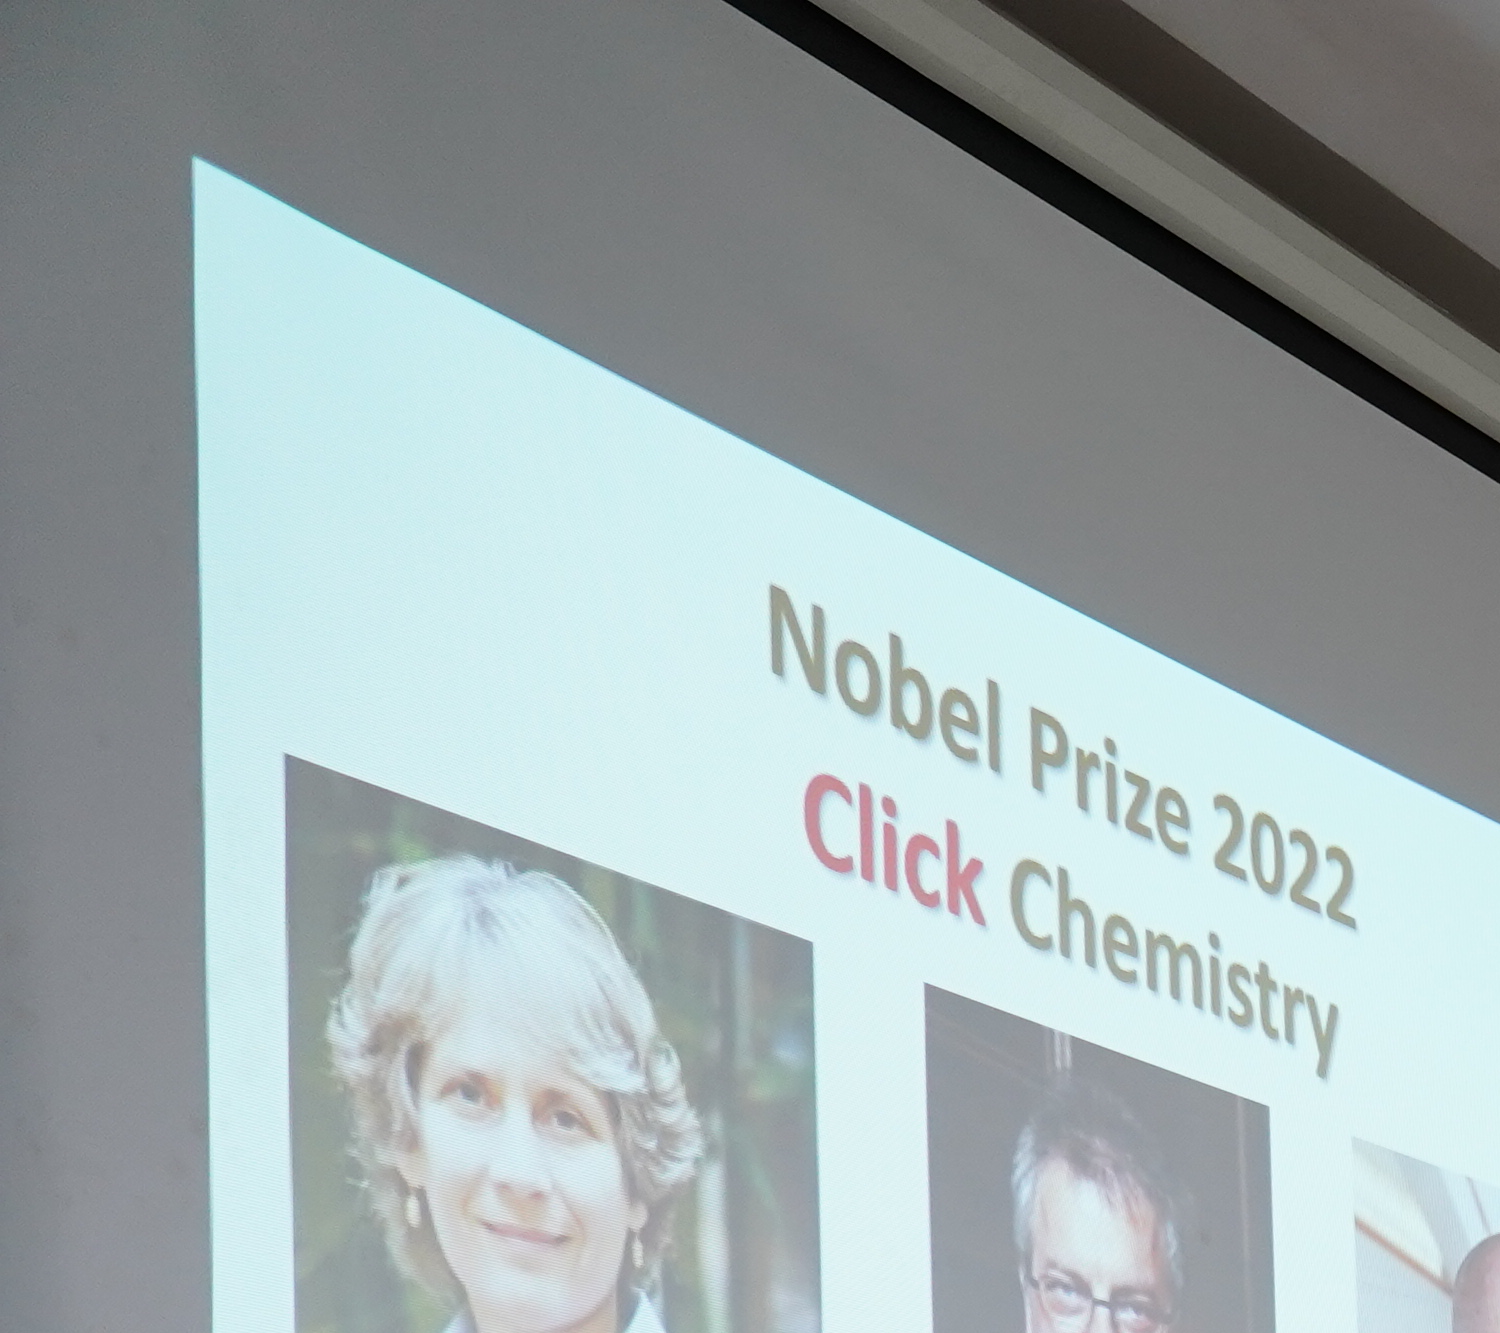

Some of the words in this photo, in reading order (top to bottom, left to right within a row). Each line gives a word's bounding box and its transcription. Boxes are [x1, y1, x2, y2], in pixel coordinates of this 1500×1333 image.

[768, 583, 1002, 773] Nobel
[1030, 706, 1192, 857] Prize
[1212, 793, 1359, 930] 2022
[803, 773, 987, 927] Click
[1010, 858, 1340, 1079] Chemistry
